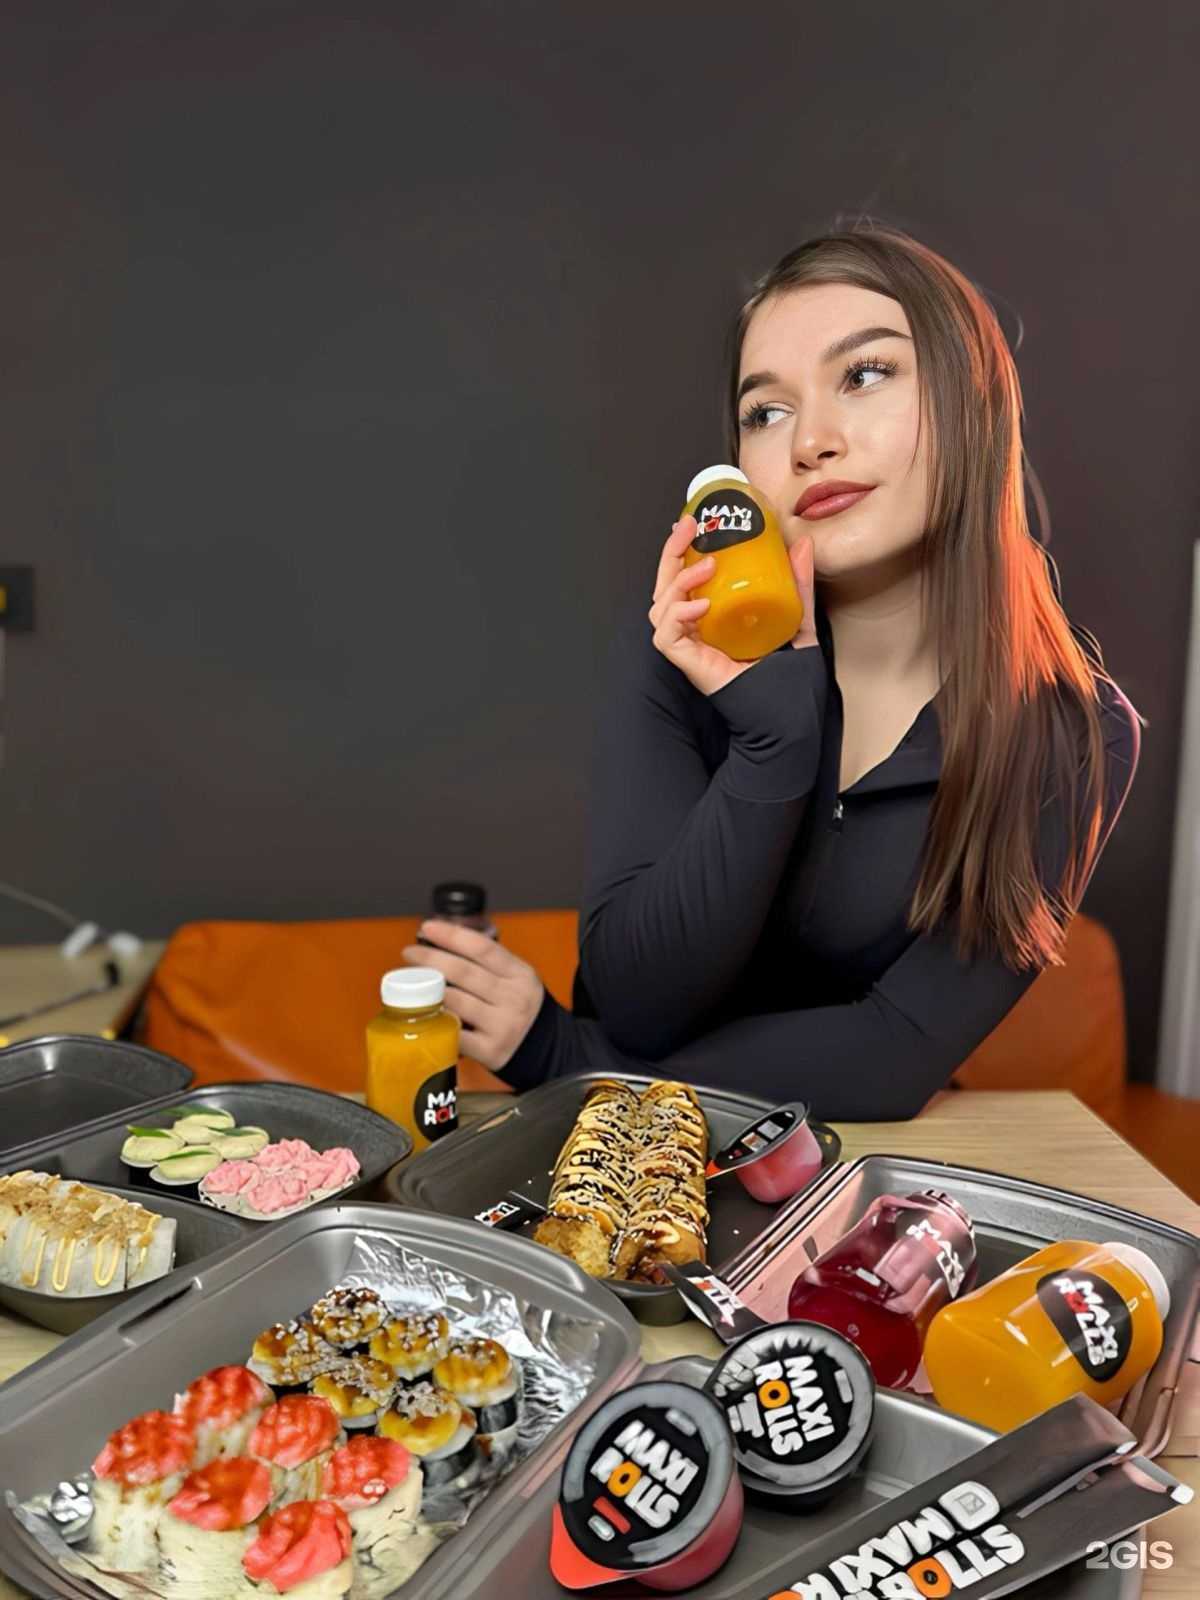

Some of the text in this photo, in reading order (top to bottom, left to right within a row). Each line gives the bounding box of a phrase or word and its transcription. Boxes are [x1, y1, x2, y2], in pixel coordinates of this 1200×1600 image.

[701, 505, 752, 521] MAXI
[424, 1103, 457, 1126] ROL
[428, 1090, 457, 1109] MA
[1052, 1278, 1106, 1366] ROLLS
[1075, 1281, 1118, 1359] MAXI
[753, 1360, 804, 1456] ROLLS
[785, 1355, 835, 1443] MAXI
[590, 1448, 680, 1529] ROLLS
[613, 1420, 699, 1496] MAXI
[828, 1506, 956, 1594] MAXI
